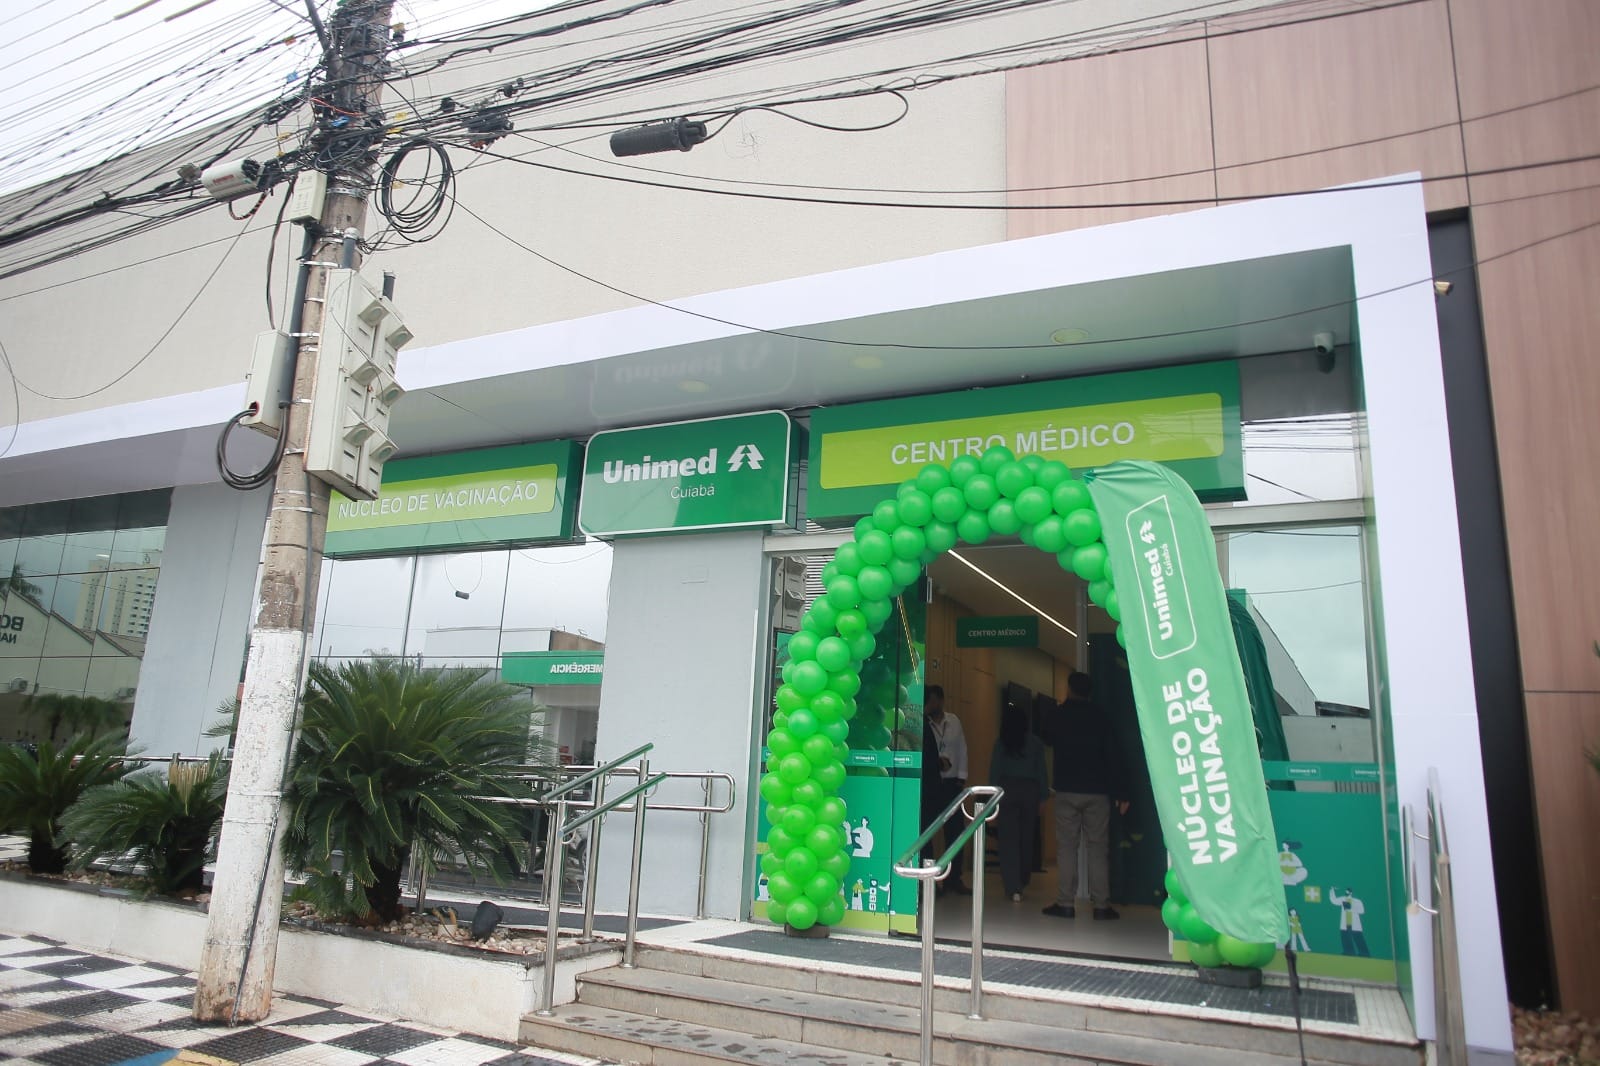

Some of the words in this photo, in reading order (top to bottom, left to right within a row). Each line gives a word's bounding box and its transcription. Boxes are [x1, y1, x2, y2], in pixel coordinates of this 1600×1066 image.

[891, 434, 1006, 465] CENTRO
[1016, 422, 1136, 453] MÉDICO
[603, 448, 718, 484] Unimed
[407, 494, 429, 512] DE
[434, 480, 538, 509] VACINAÇÃO
[670, 483, 715, 499] Cuiabá
[1159, 543, 1174, 577] Cuiabá
[1144, 547, 1173, 641] Unimed
[968, 629, 997, 637] CENTRO
[997, 627, 1026, 637] MÉDICO
[1162, 681, 1187, 725] DE
[1186, 667, 1238, 863] VACINAÇÃO
[1172, 731, 1213, 865] NÚCLEO
